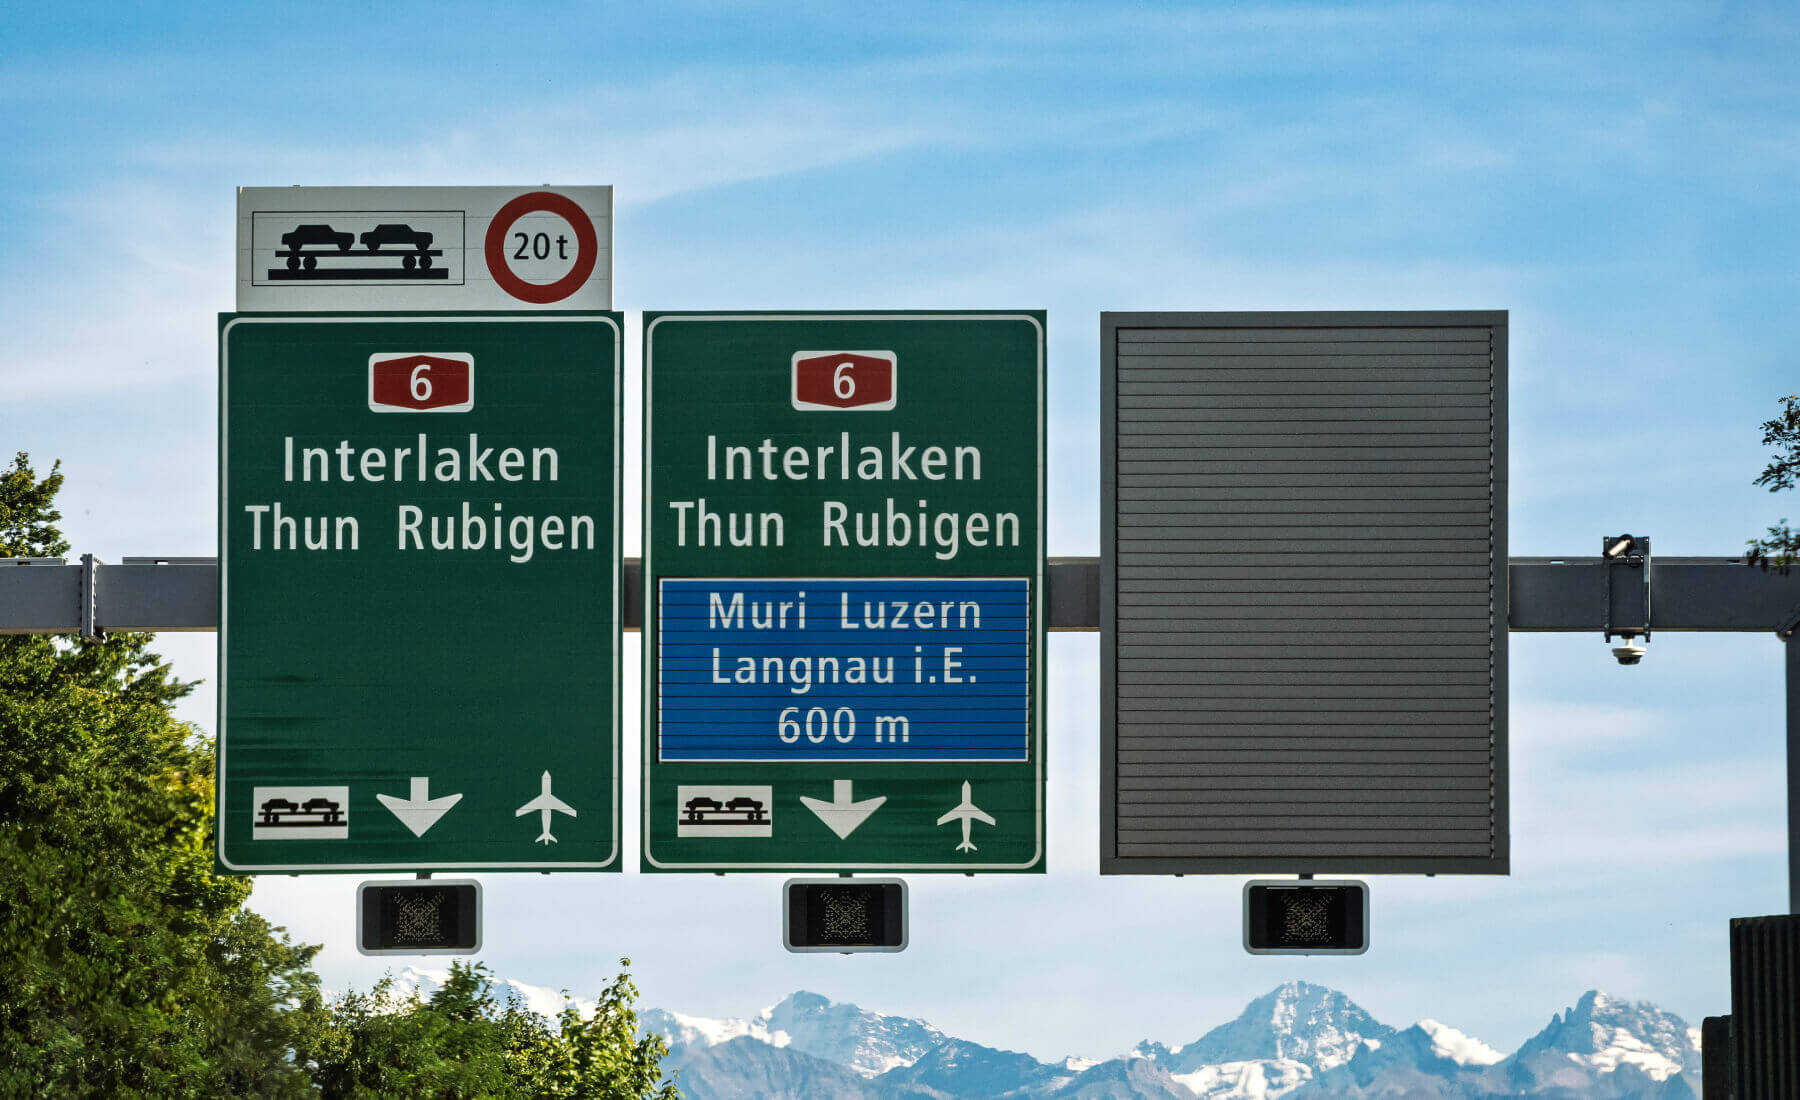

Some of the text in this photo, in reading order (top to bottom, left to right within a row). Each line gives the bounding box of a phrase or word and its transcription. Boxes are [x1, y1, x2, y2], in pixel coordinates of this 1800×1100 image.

[410, 364, 433, 402] 6
[833, 362, 856, 400] 6
[284, 433, 559, 482] Interlaken
[707, 431, 981, 480] Interlaken
[244, 502, 595, 563] Thun Rubigen
[669, 497, 1020, 561] Thun Rubigen
[709, 591, 981, 629] Muri Luzern
[712, 645, 977, 695] Langnau i.E.
[778, 706, 910, 744] 600 m
